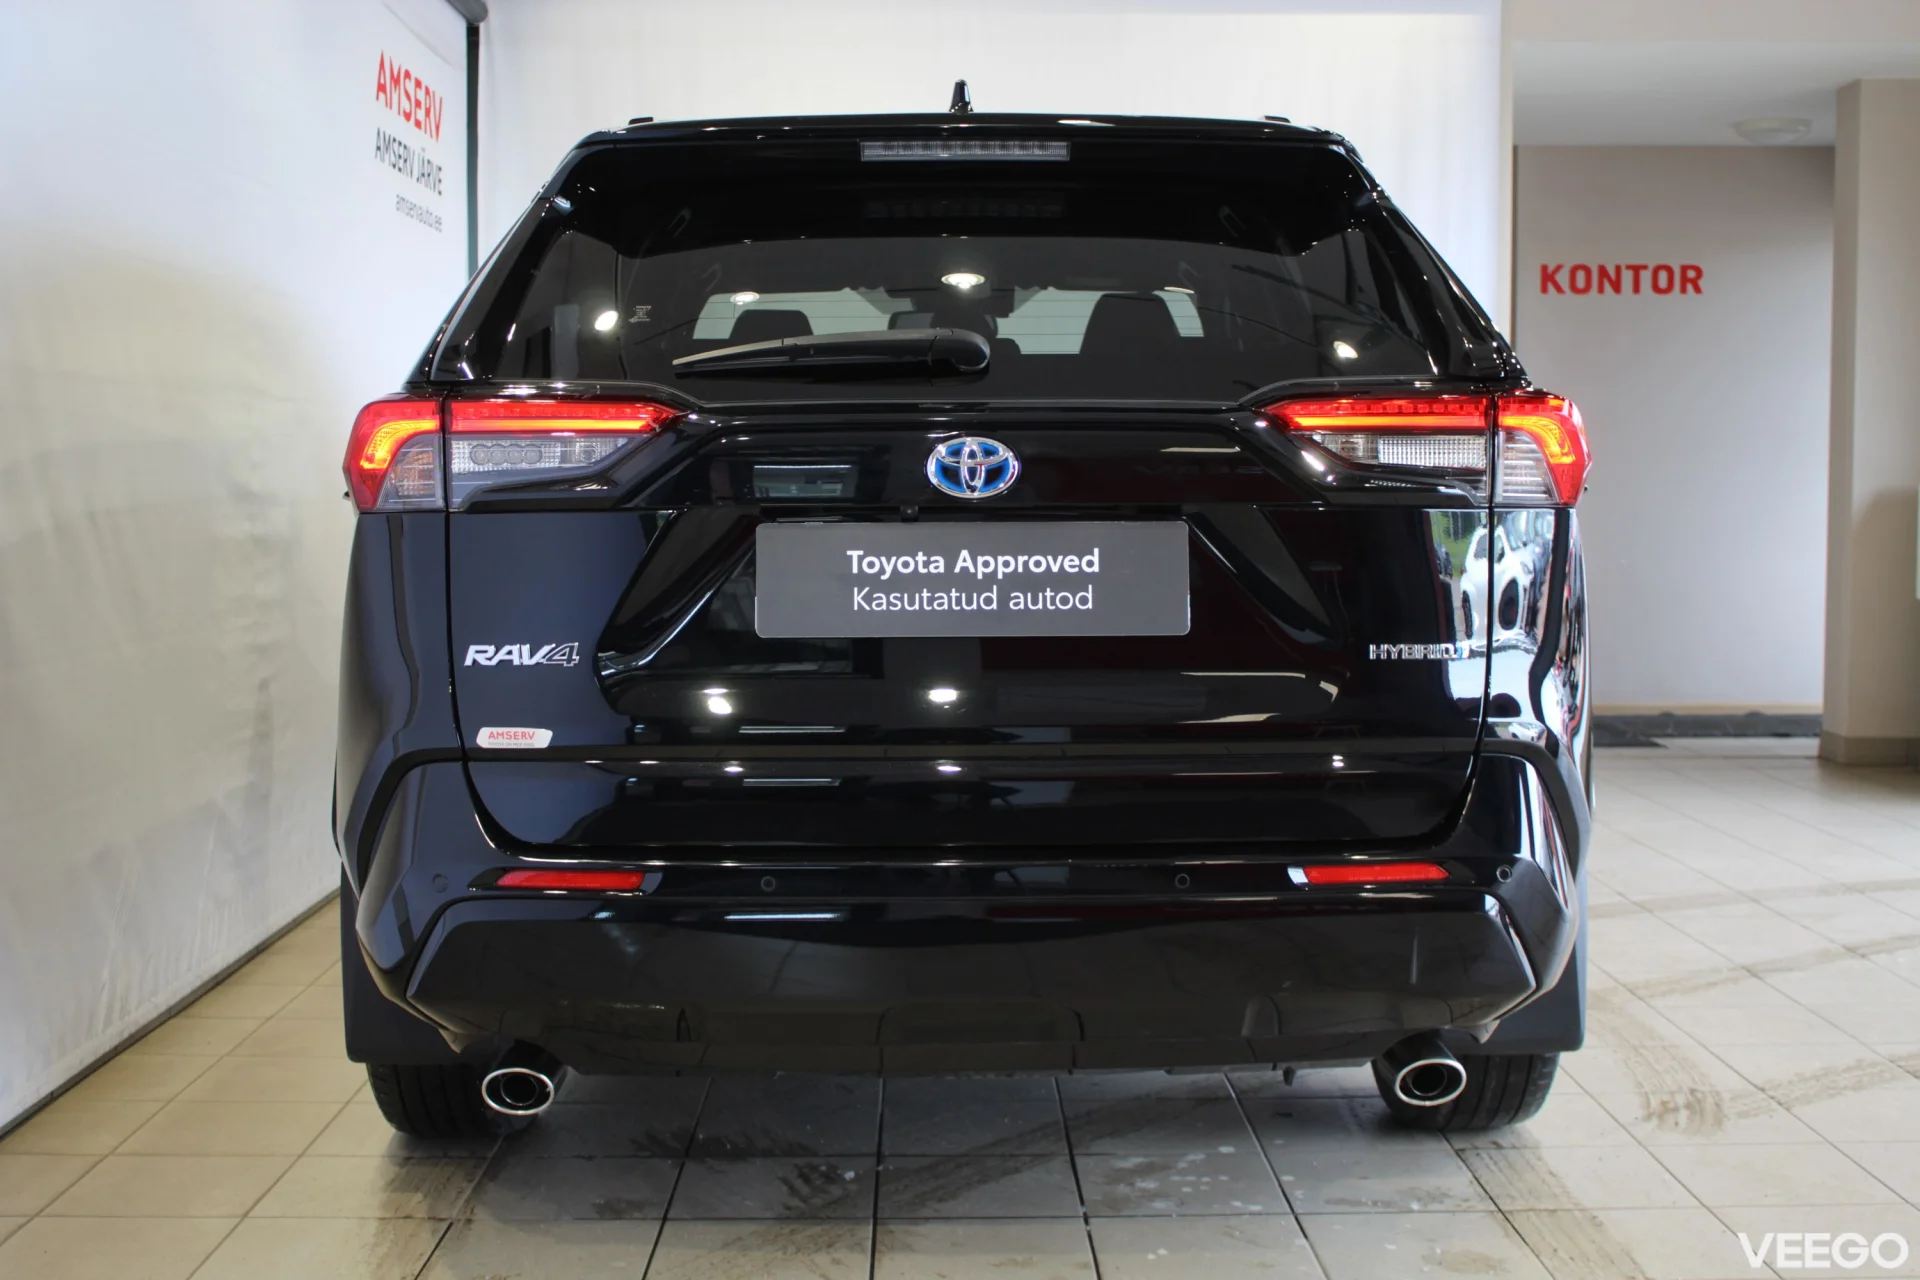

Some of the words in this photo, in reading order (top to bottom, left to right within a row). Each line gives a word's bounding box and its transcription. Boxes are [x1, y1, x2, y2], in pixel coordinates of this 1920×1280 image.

[375, 49, 443, 143] AMSERV
[375, 127, 415, 180] AMSERV
[416, 147, 442, 196] JÄRVE
[1539, 263, 1704, 296] KONTOR
[846, 549, 946, 580] Toyota
[953, 547, 1101, 580] Approved
[852, 585, 998, 611] Kasutatud
[1009, 584, 1094, 611] autod
[464, 642, 580, 667] RAV4
[1369, 643, 1458, 660] HYBRID
[488, 731, 535, 741] AMSERV
